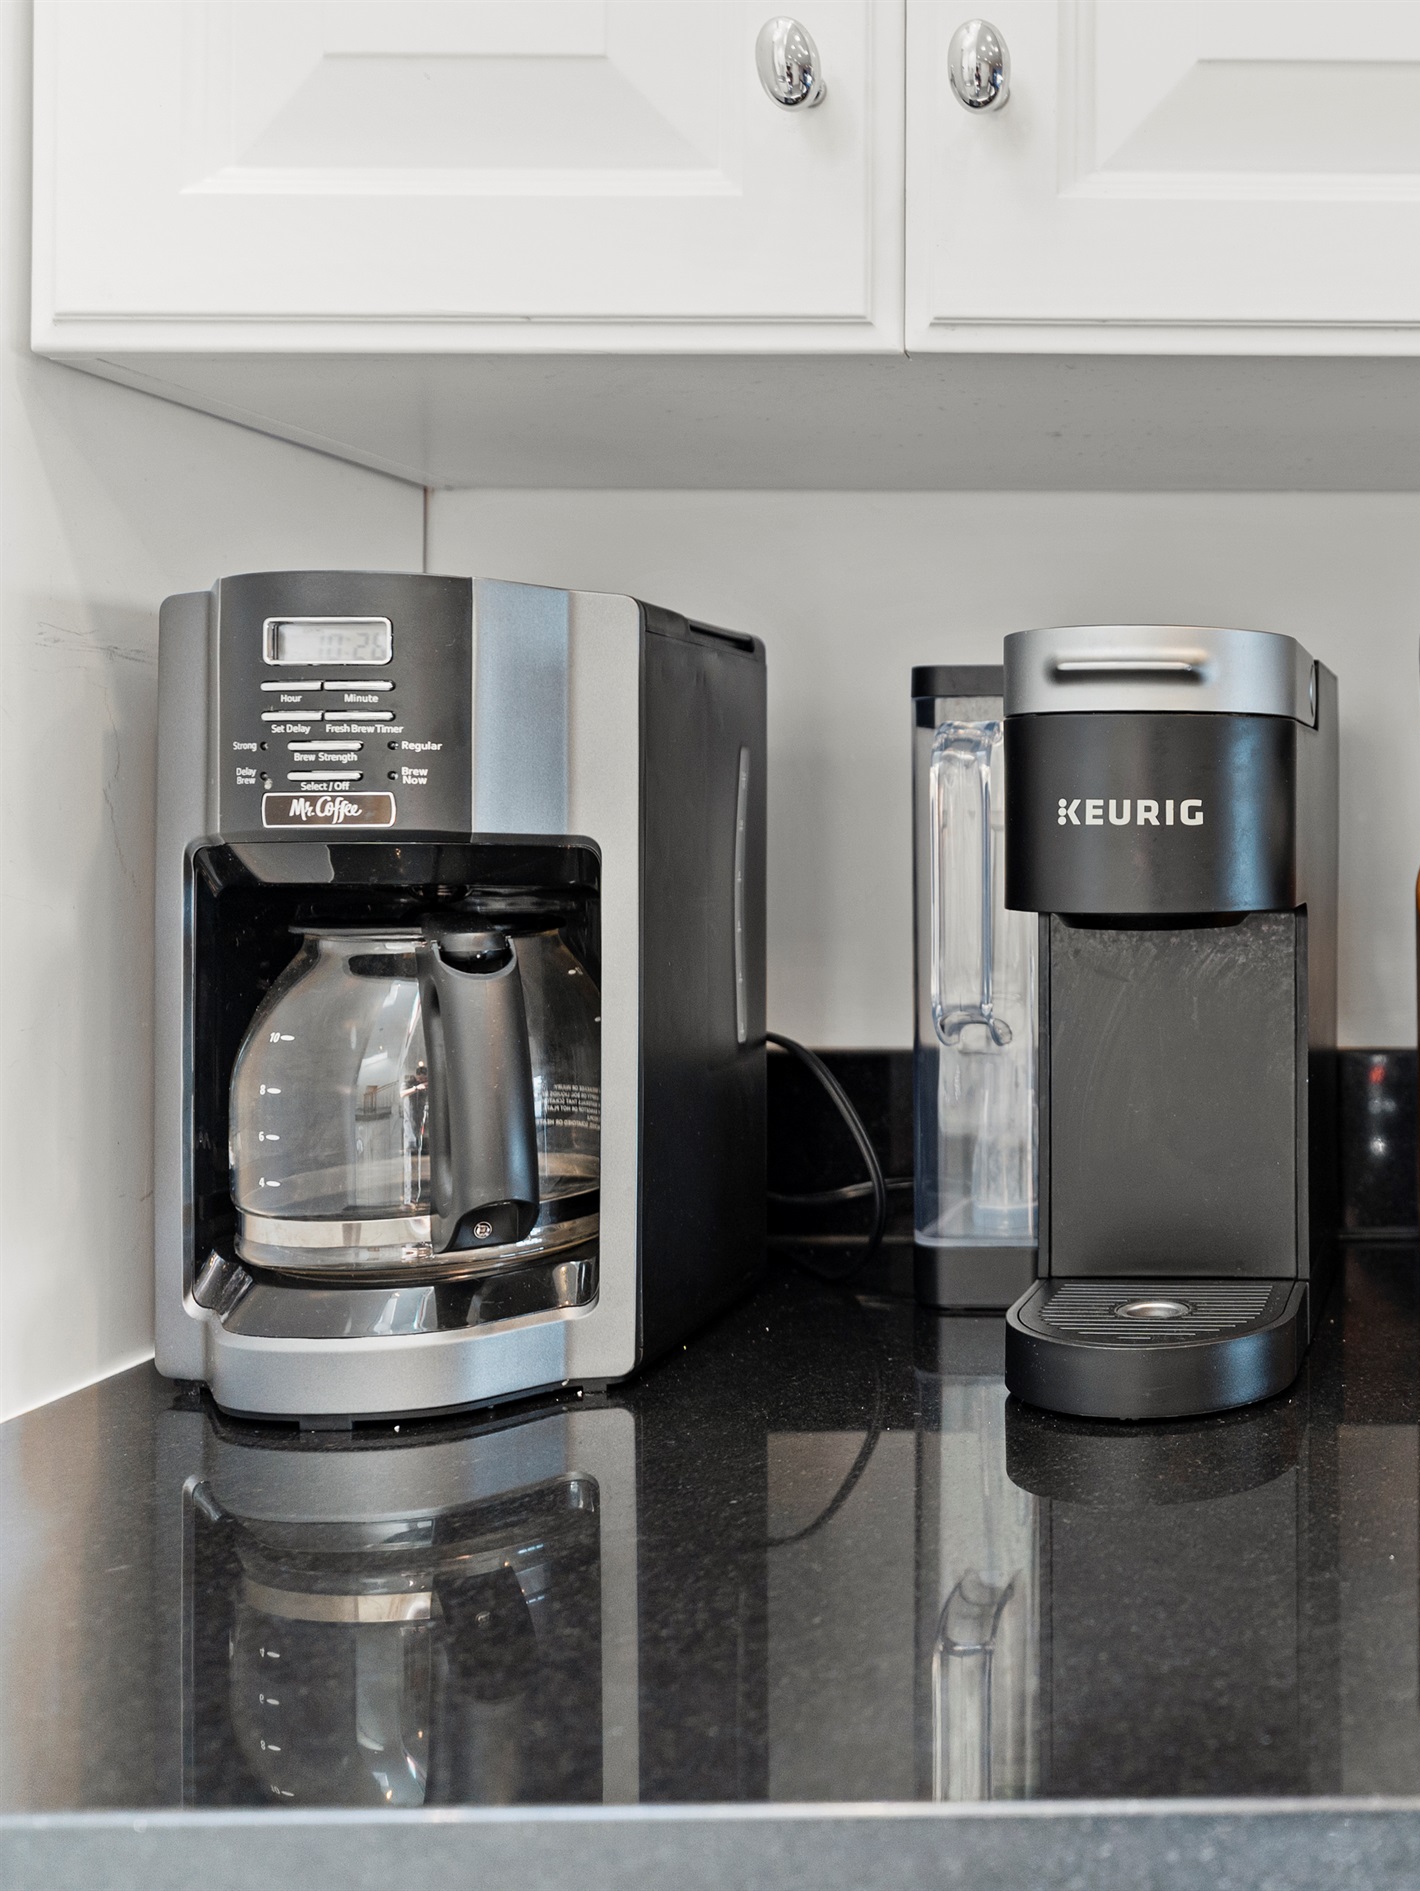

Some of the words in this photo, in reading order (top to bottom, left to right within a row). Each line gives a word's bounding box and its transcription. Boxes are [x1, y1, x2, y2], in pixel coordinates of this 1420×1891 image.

[280, 694, 302, 703] Hour
[344, 693, 379, 703] Minute
[271, 724, 285, 733] Set
[286, 724, 311, 735] Delay
[326, 724, 350, 734] Fresh
[351, 724, 375, 734] Brew
[375, 724, 404, 734] Timer
[233, 741, 257, 752] Strong
[401, 741, 442, 752] Regular
[294, 752, 316, 762] Brew
[318, 752, 358, 764] Strength
[236, 767, 257, 778] Delay
[401, 767, 428, 776] Brew
[236, 776, 256, 785] Brew
[300, 781, 328, 791] Select
[334, 781, 350, 791] Off
[402, 776, 428, 785] Now
[315, 796, 362, 824] Coffee
[1057, 798, 1204, 826] KEURIG
[269, 1032, 281, 1043] 10
[259, 1084, 266, 1095] 8
[258, 1131, 265, 1142] 6
[258, 1177, 265, 1188] 4
